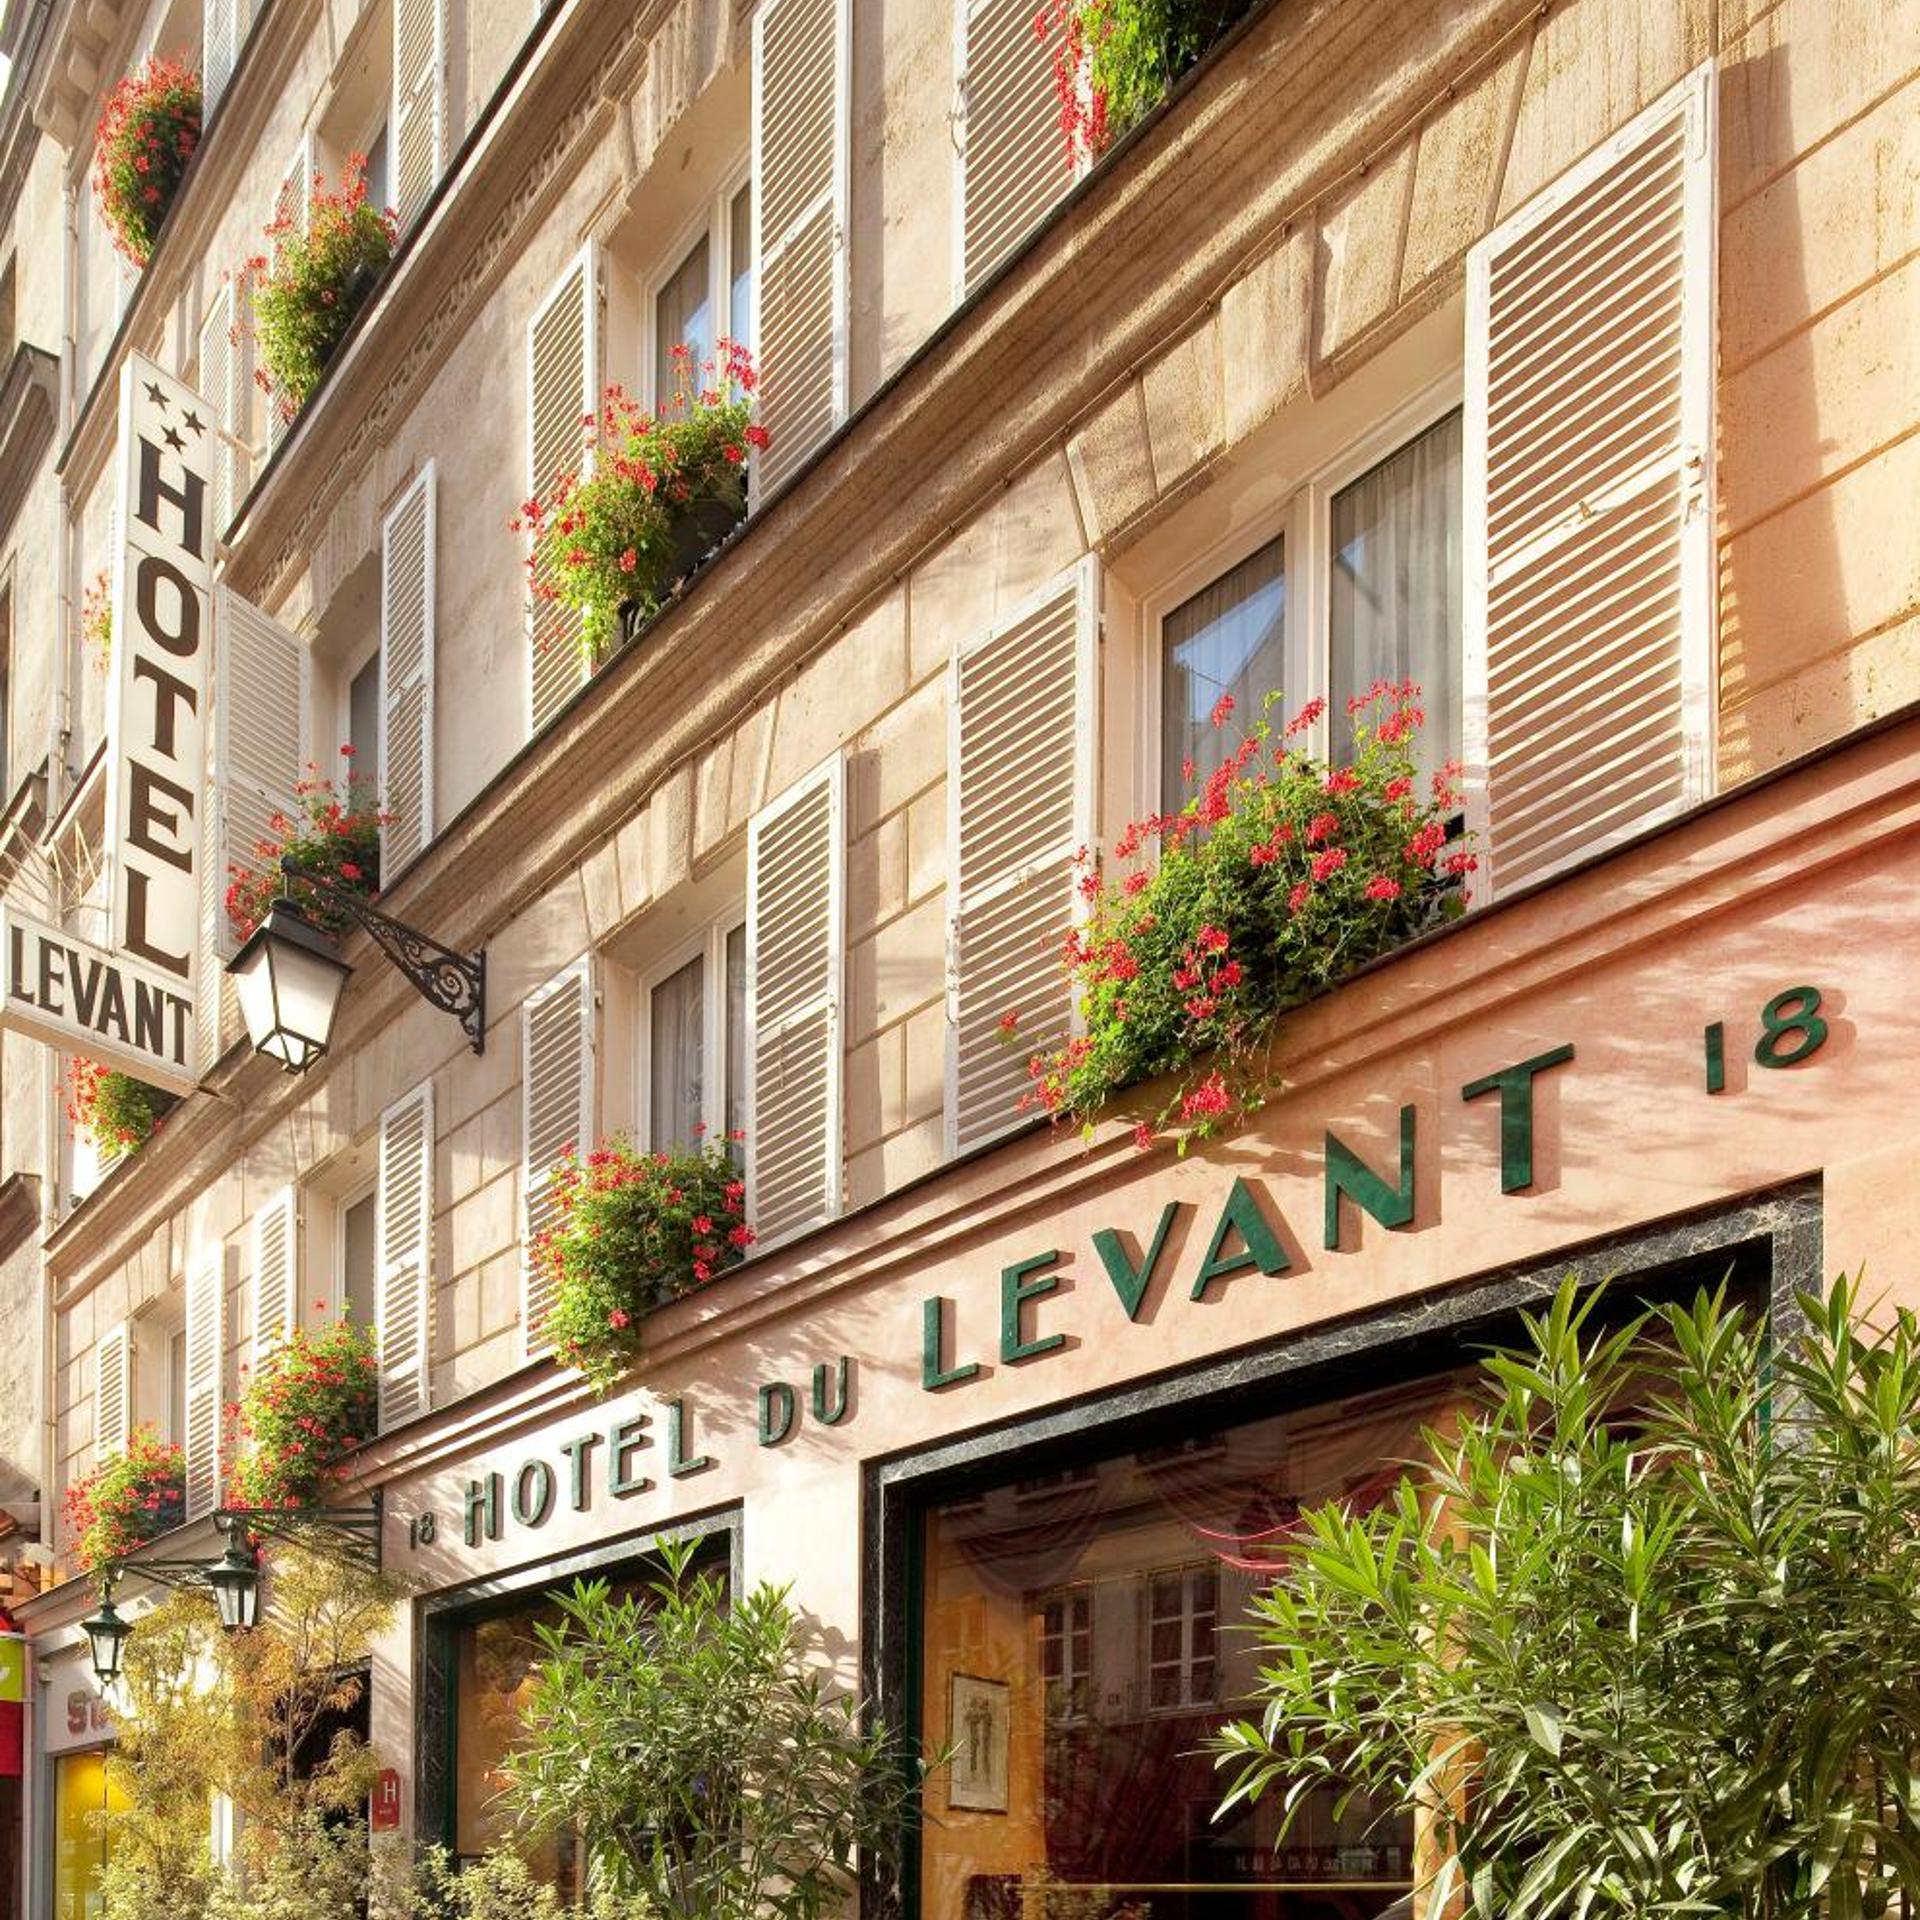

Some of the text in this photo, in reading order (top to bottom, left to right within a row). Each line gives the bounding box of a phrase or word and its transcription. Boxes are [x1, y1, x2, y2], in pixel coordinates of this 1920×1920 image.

[120, 433, 209, 980] HOTEL
[10, 924, 193, 1066] LEVANT
[409, 985, 1830, 1550] 18 HOTEL DU LEVANT 18
[383, 1780, 397, 1804] H
